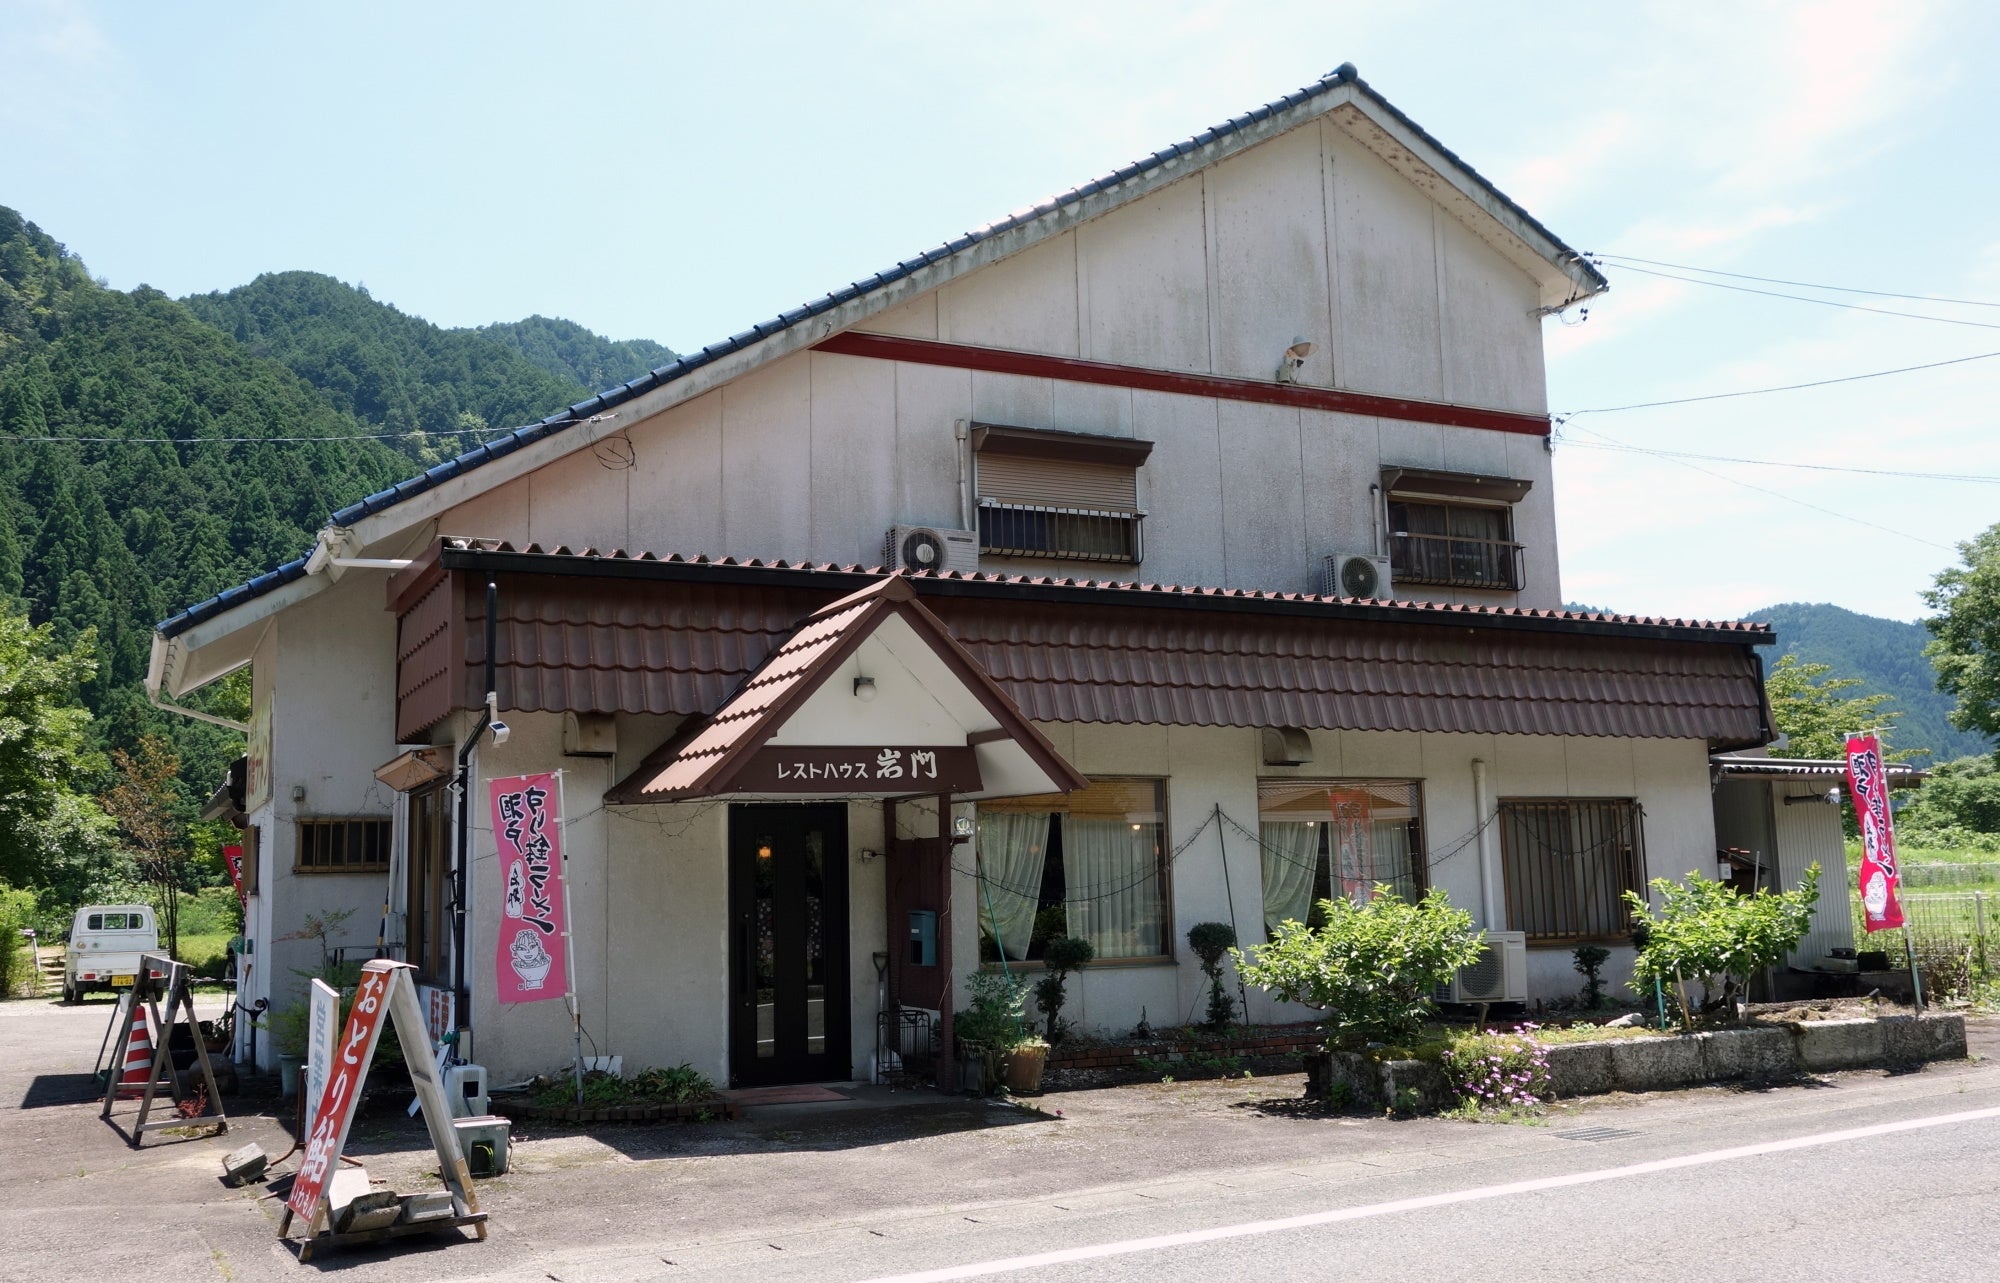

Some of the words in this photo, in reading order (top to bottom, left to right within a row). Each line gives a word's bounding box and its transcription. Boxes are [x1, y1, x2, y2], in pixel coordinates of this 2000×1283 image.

[777, 762, 869, 779] レストハウス
[876, 748, 938, 779] 岩門
[301, 972, 384, 1184] おとり鮎
[289, 1182, 317, 1220] いわもん
